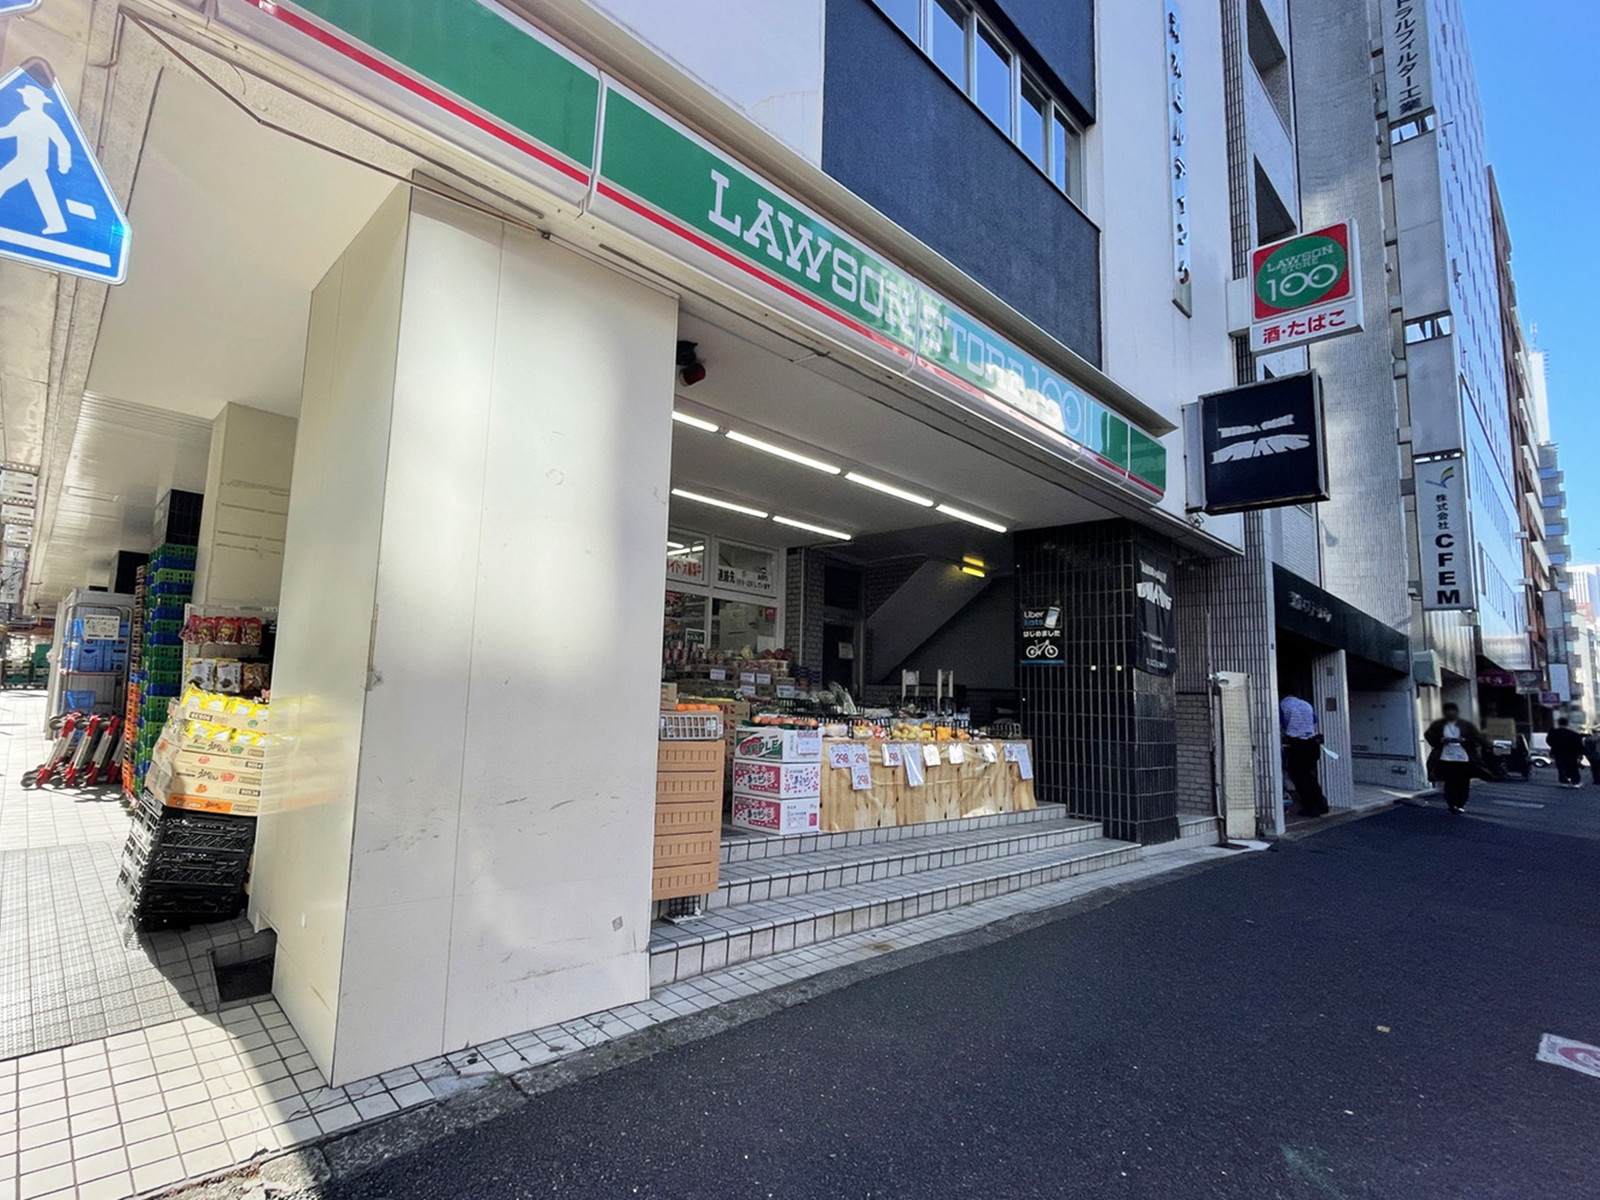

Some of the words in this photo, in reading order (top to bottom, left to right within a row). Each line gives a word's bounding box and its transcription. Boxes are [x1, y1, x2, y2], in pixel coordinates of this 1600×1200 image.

[708, 168, 916, 336] LAWSON
[1266, 244, 1335, 273] LAWSON
[1280, 258, 1319, 274] STORE
[1266, 263, 1338, 302] 100
[1263, 309, 1346, 345] 酒・たばこ
[1435, 493, 1450, 531] 株式会社
[1434, 533, 1461, 605] CFEM
[1023, 610, 1045, 619] Uber
[1023, 629, 1061, 638] はじめました
[746, 738, 780, 754] APPLE
